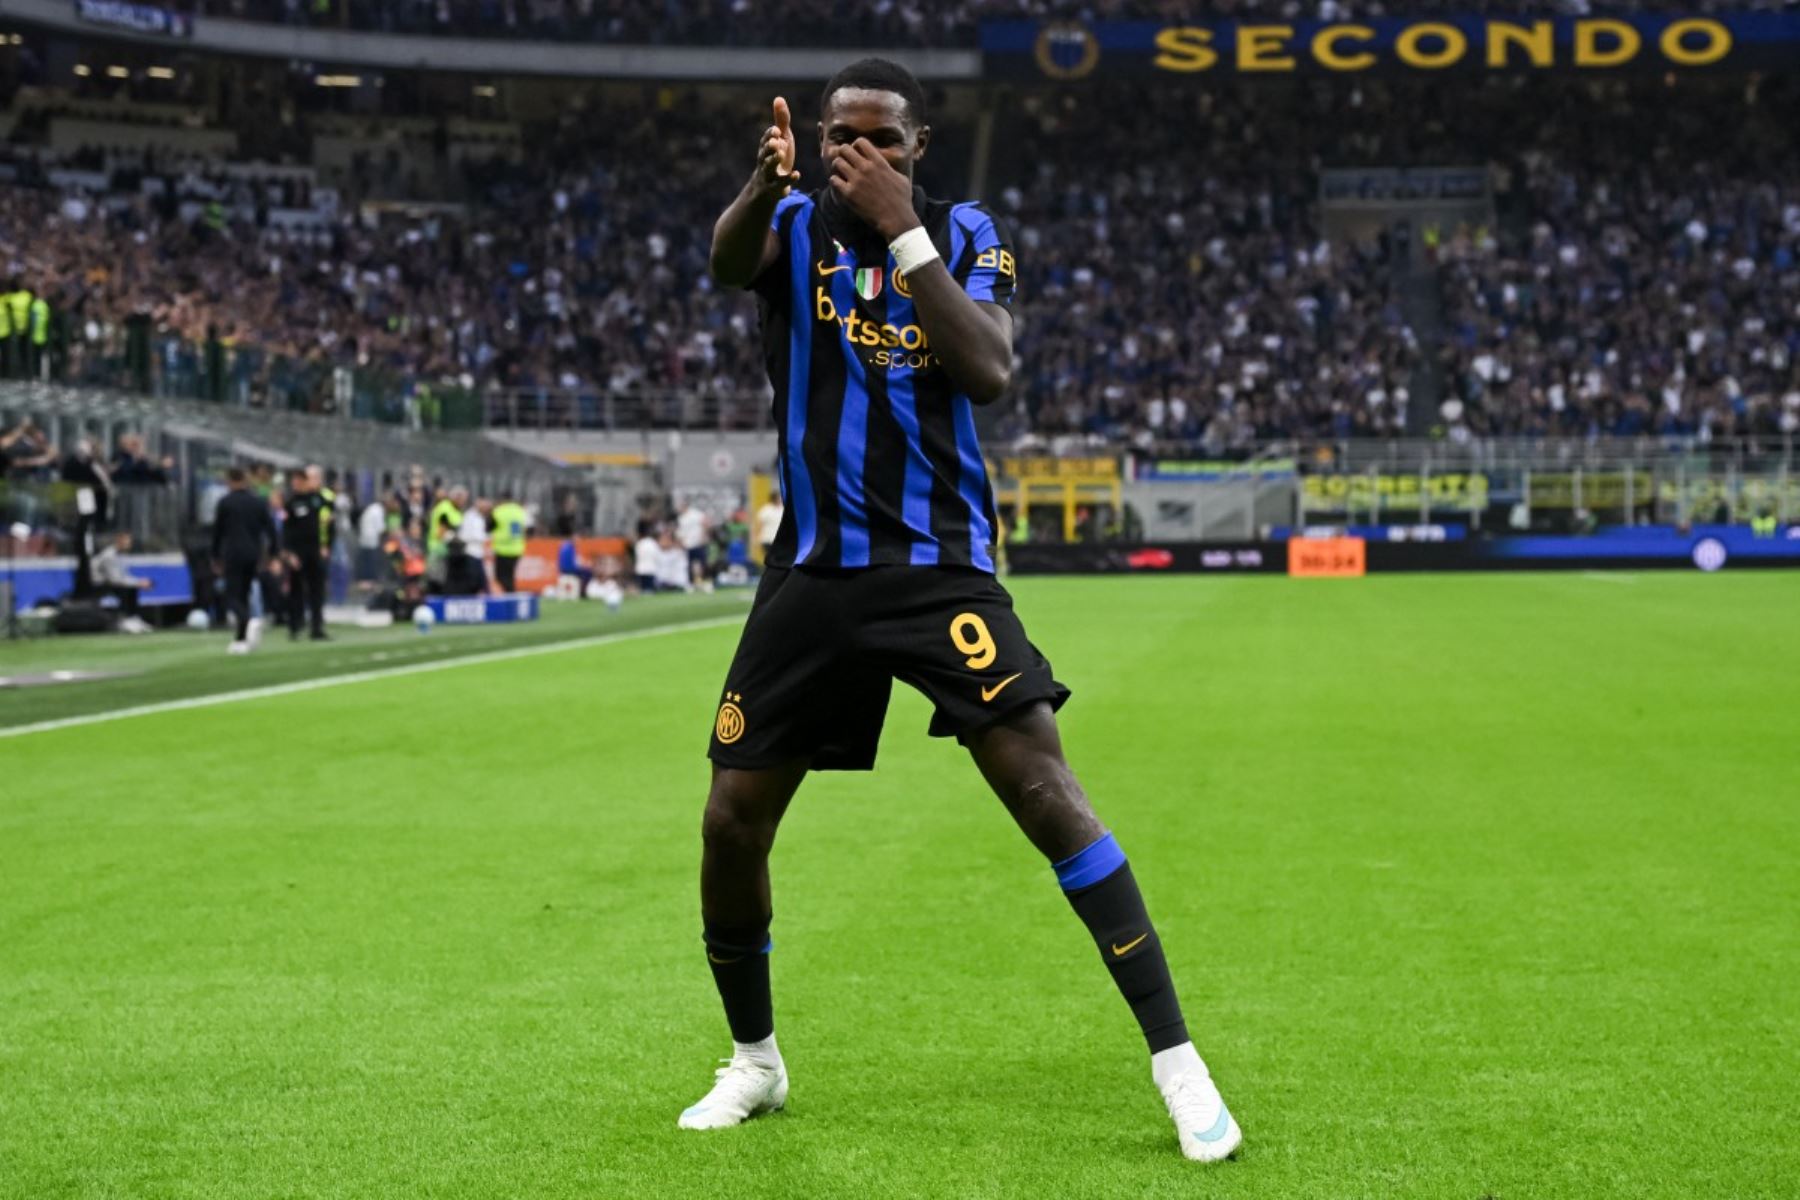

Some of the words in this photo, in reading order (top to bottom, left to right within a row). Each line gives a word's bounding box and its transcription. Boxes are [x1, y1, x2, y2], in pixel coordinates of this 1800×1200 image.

[1153, 18, 1733, 71] SECONDO
[816, 286, 928, 350] btsso
[950, 612, 997, 670] 9
